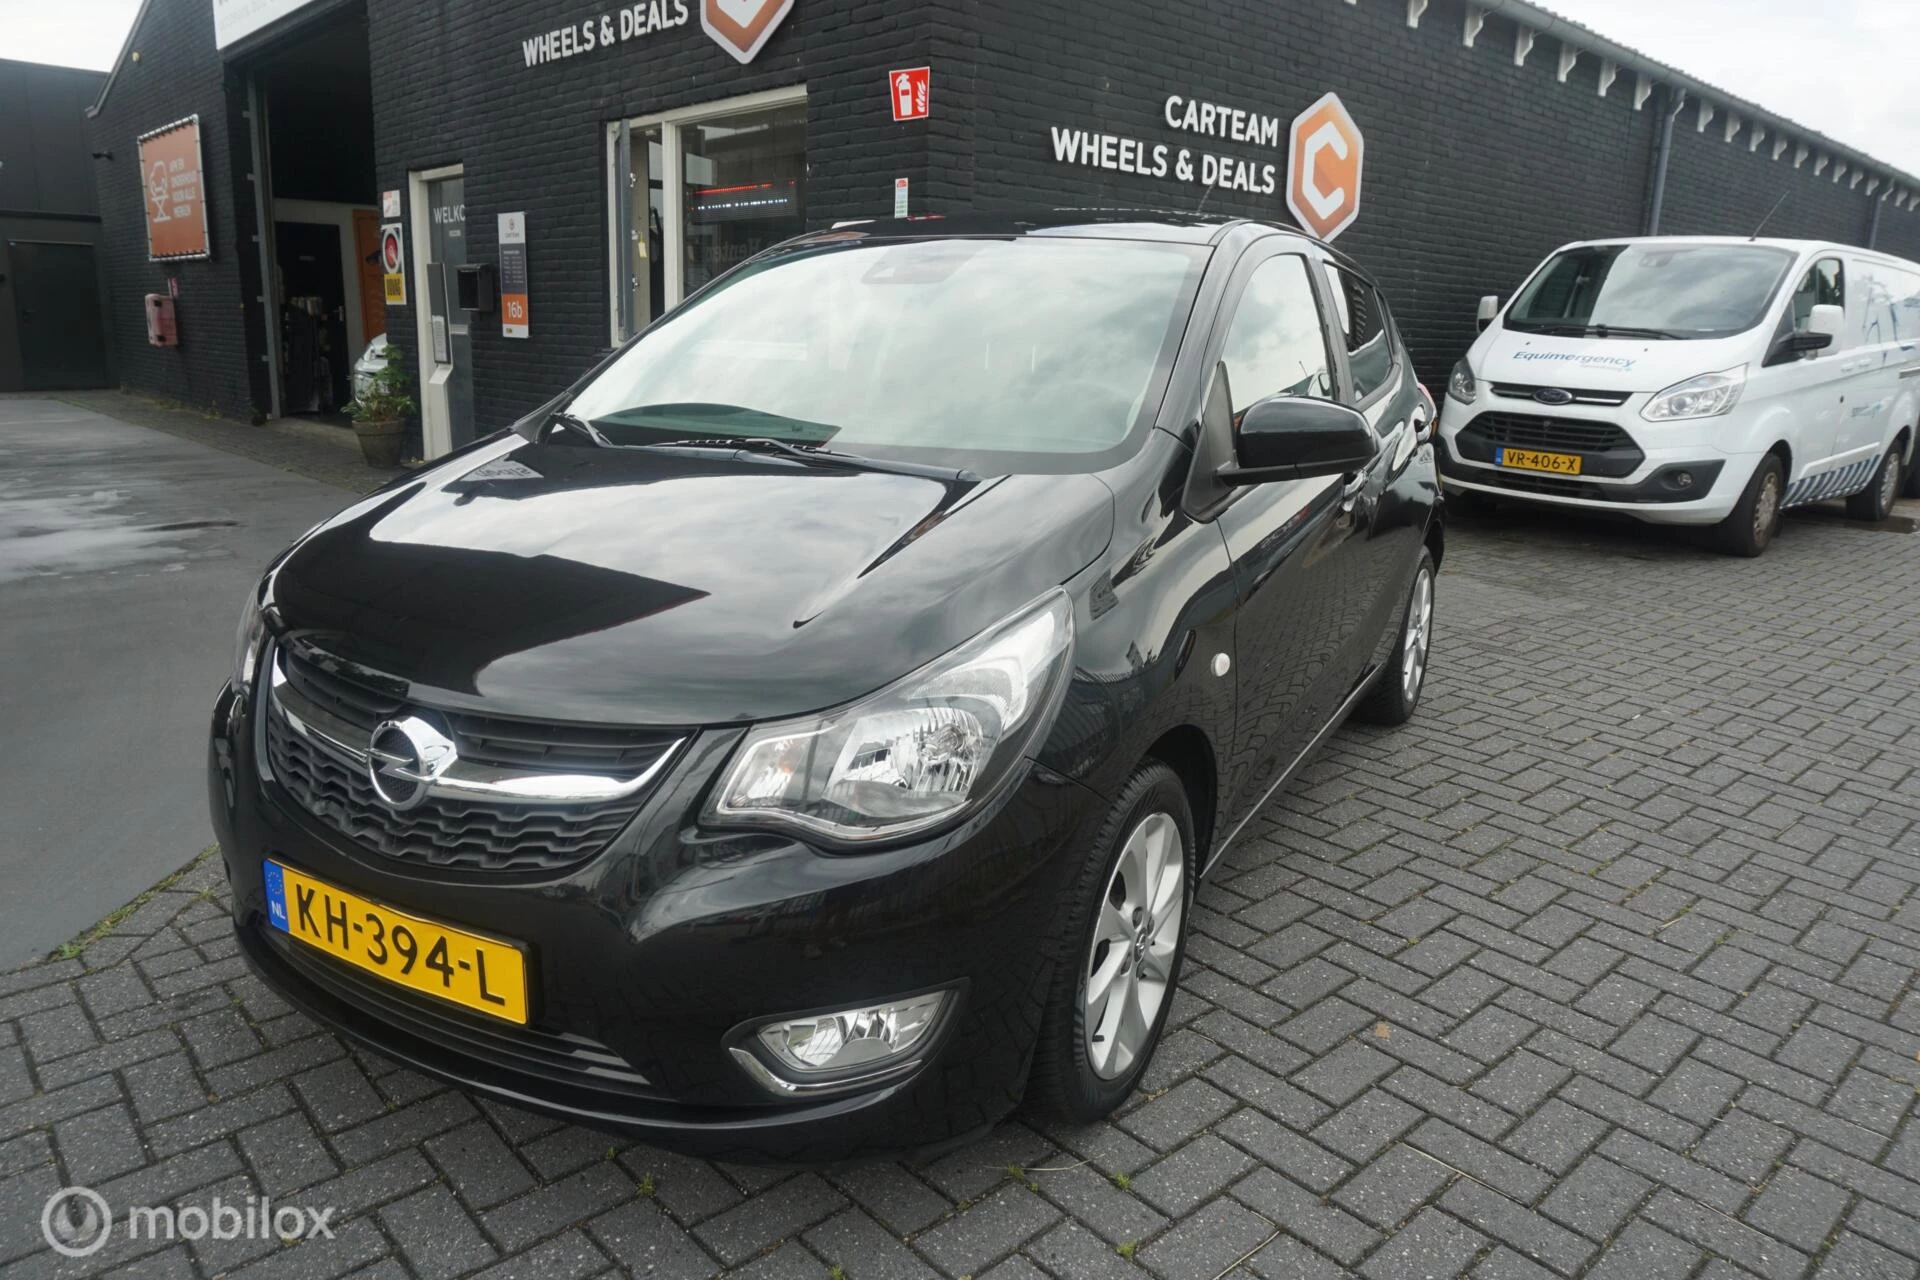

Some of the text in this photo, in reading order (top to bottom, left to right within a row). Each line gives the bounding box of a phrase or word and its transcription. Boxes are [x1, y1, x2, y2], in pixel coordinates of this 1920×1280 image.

[522, 0, 689, 68] WHEELS & DEALS
[1165, 95, 1279, 147] CARTEAM
[1051, 127, 1276, 194] WHEELS & DEALS
[507, 301, 522, 319] 16b
[1513, 351, 1636, 367] Equimergency
[1507, 450, 1576, 471] VR-406-X
[271, 901, 286, 920] NL
[296, 884, 505, 1006] KH-394-L
